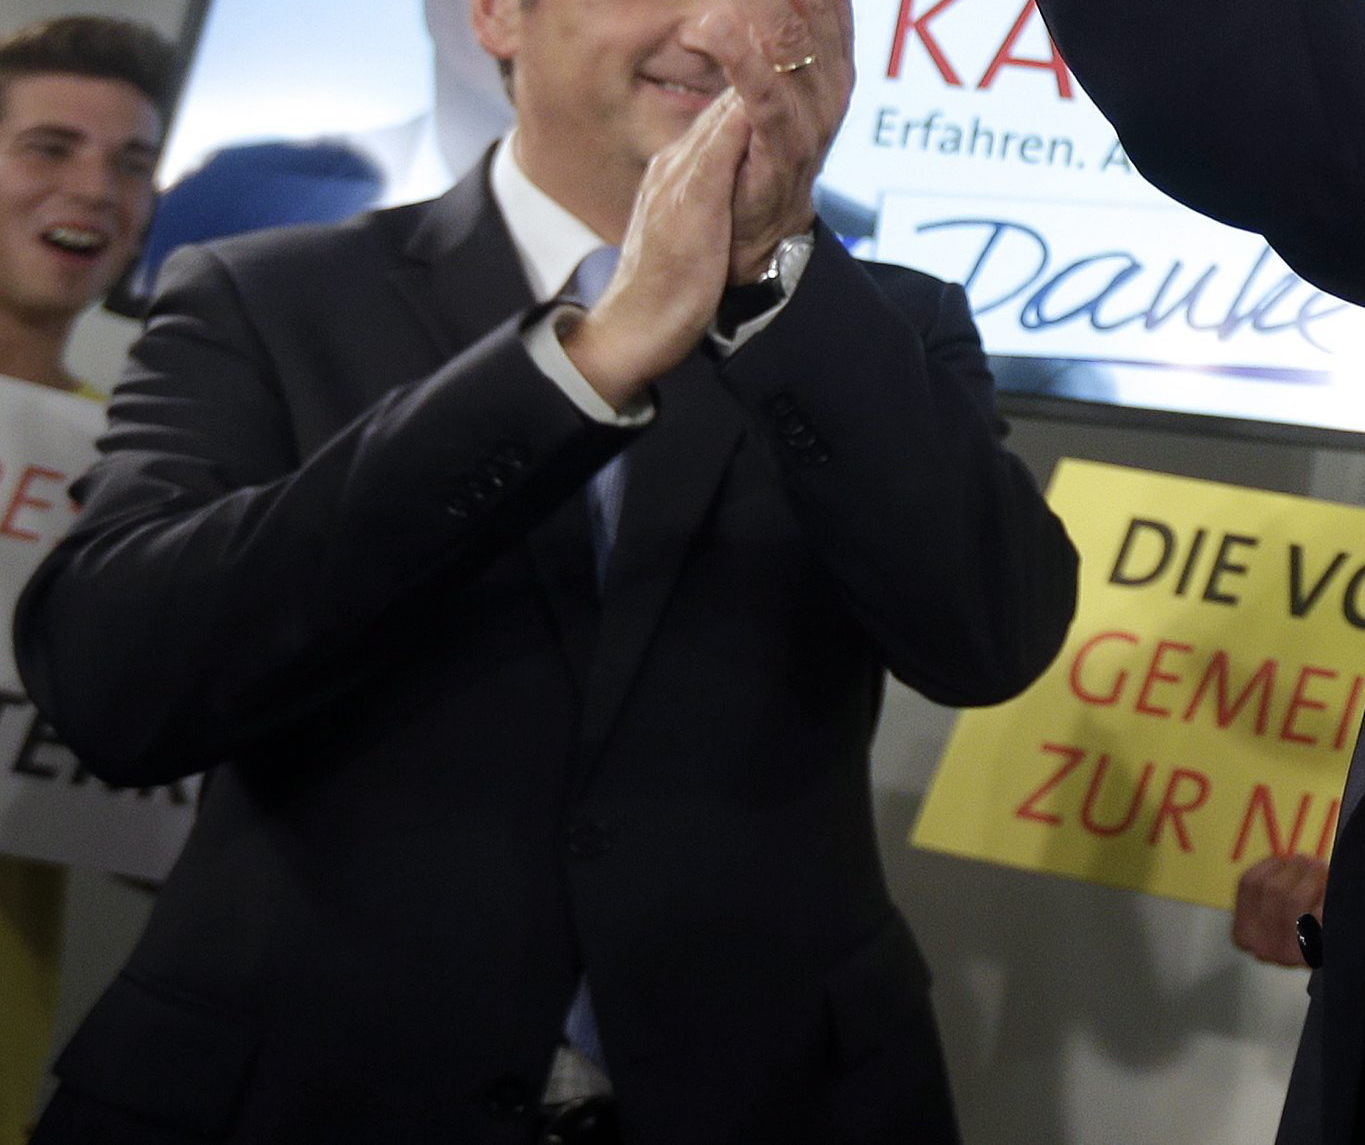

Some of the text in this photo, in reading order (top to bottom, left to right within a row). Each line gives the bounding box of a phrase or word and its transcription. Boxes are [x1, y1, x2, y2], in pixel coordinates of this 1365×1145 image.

[873, 107, 1087, 172] Erfahren.
[916, 218, 1348, 354] Danke
[1108, 516, 1259, 608] DIE
[1068, 630, 1364, 753] GEMEI
[1015, 743, 1212, 854] ZUR
